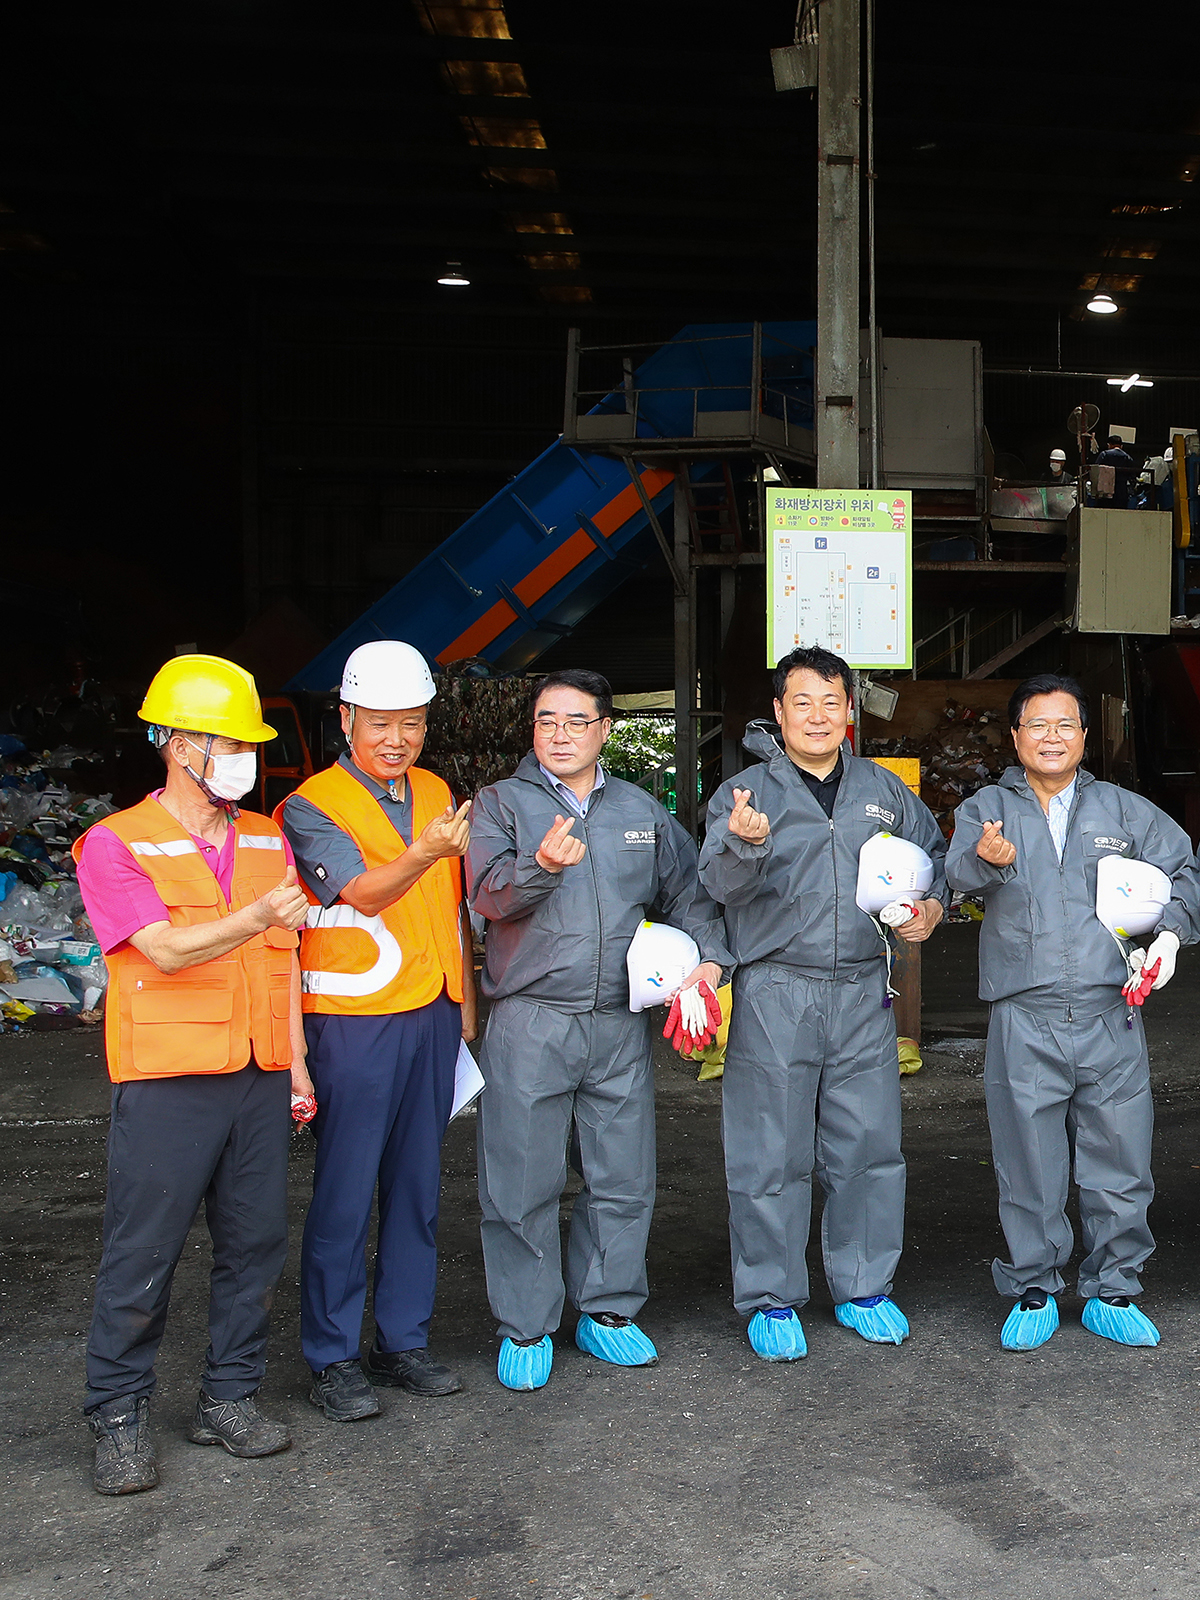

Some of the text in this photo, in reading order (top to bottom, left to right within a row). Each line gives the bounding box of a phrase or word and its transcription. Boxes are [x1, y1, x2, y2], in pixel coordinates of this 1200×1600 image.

[774, 497, 874, 512] 화재방지장치 위치
[816, 540, 825, 548] 1F
[868, 569, 878, 577] 2F
